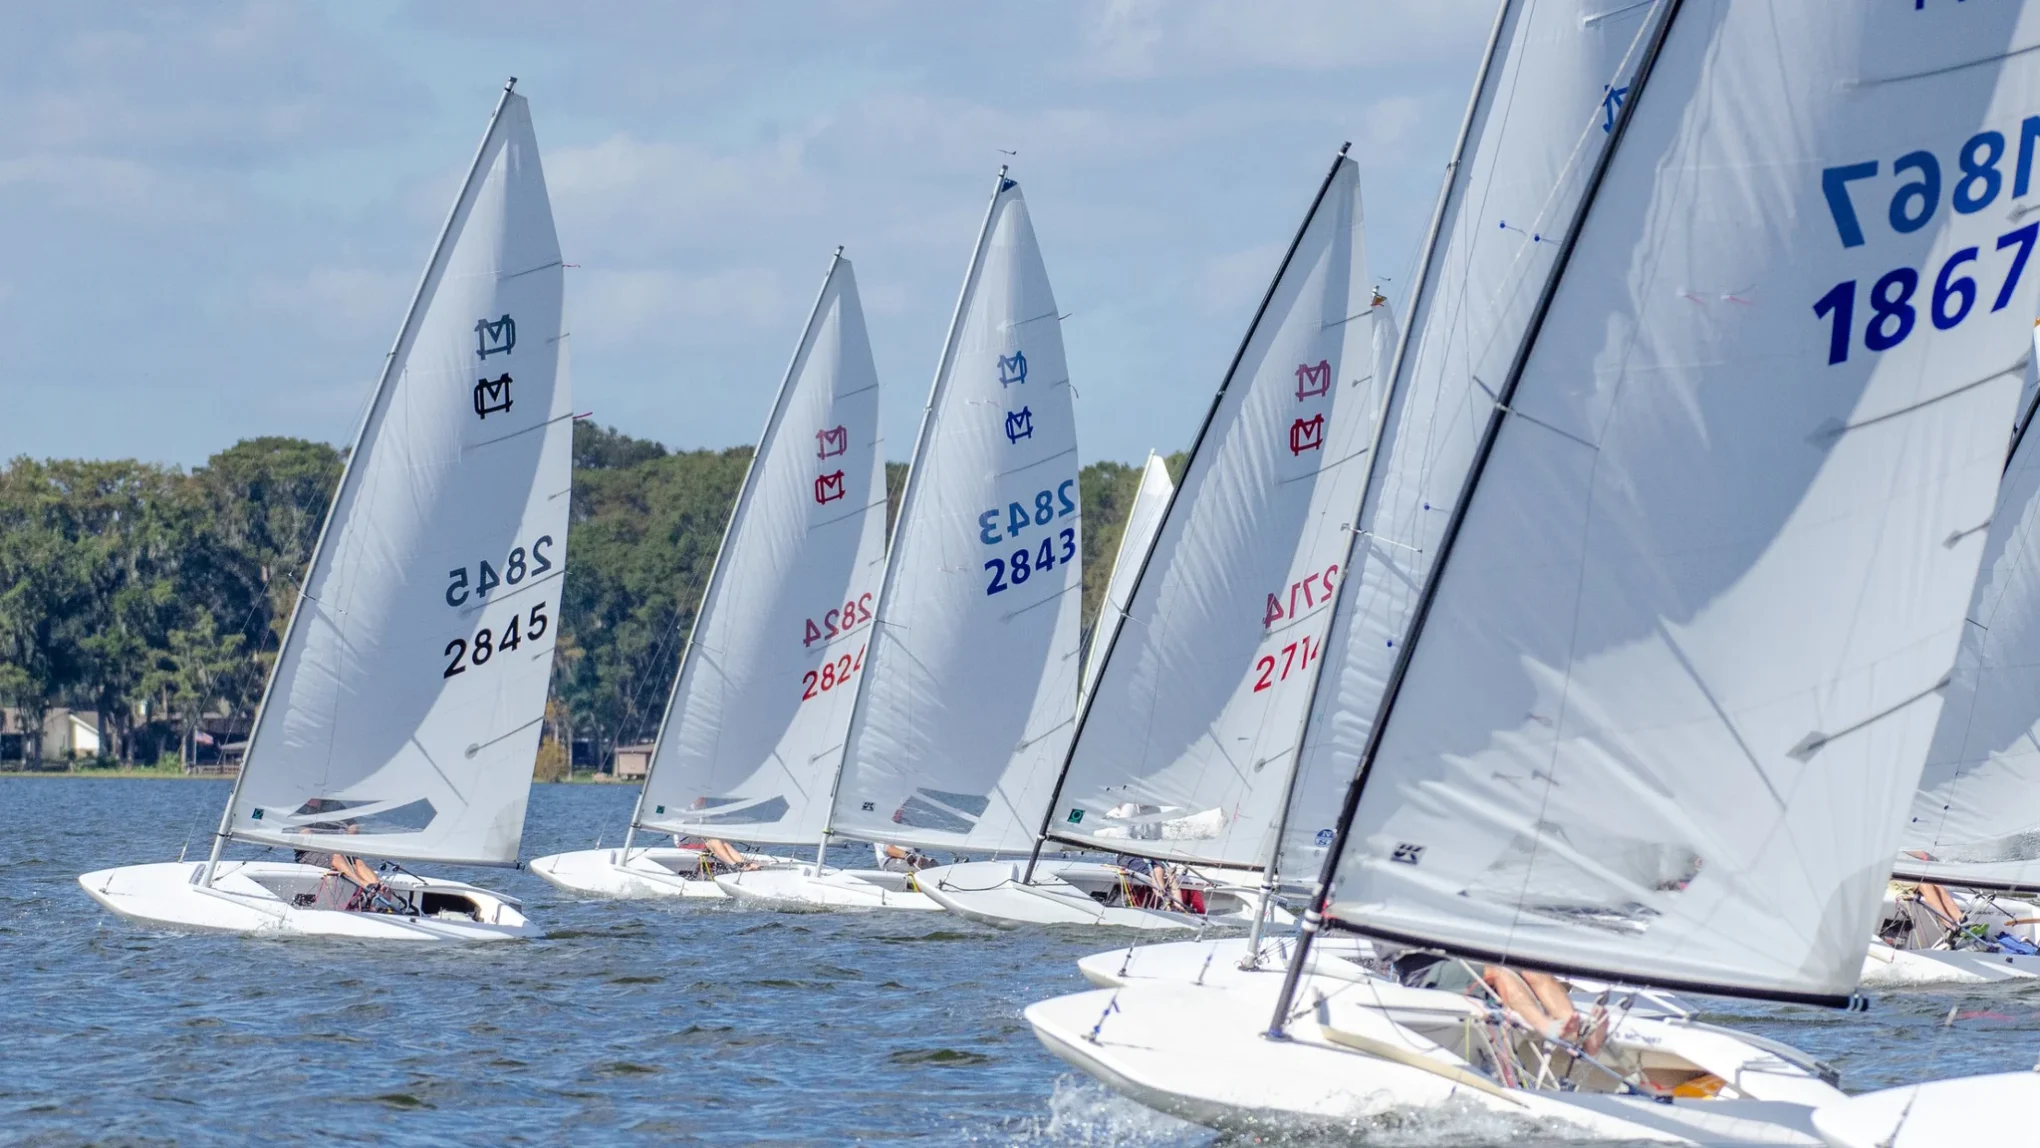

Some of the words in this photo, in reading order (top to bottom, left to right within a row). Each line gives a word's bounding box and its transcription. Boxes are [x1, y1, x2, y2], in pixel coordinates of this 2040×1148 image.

[1812, 220, 2040, 366] 1867
[984, 527, 1076, 596] 2843
[443, 601, 548, 679] 2845
